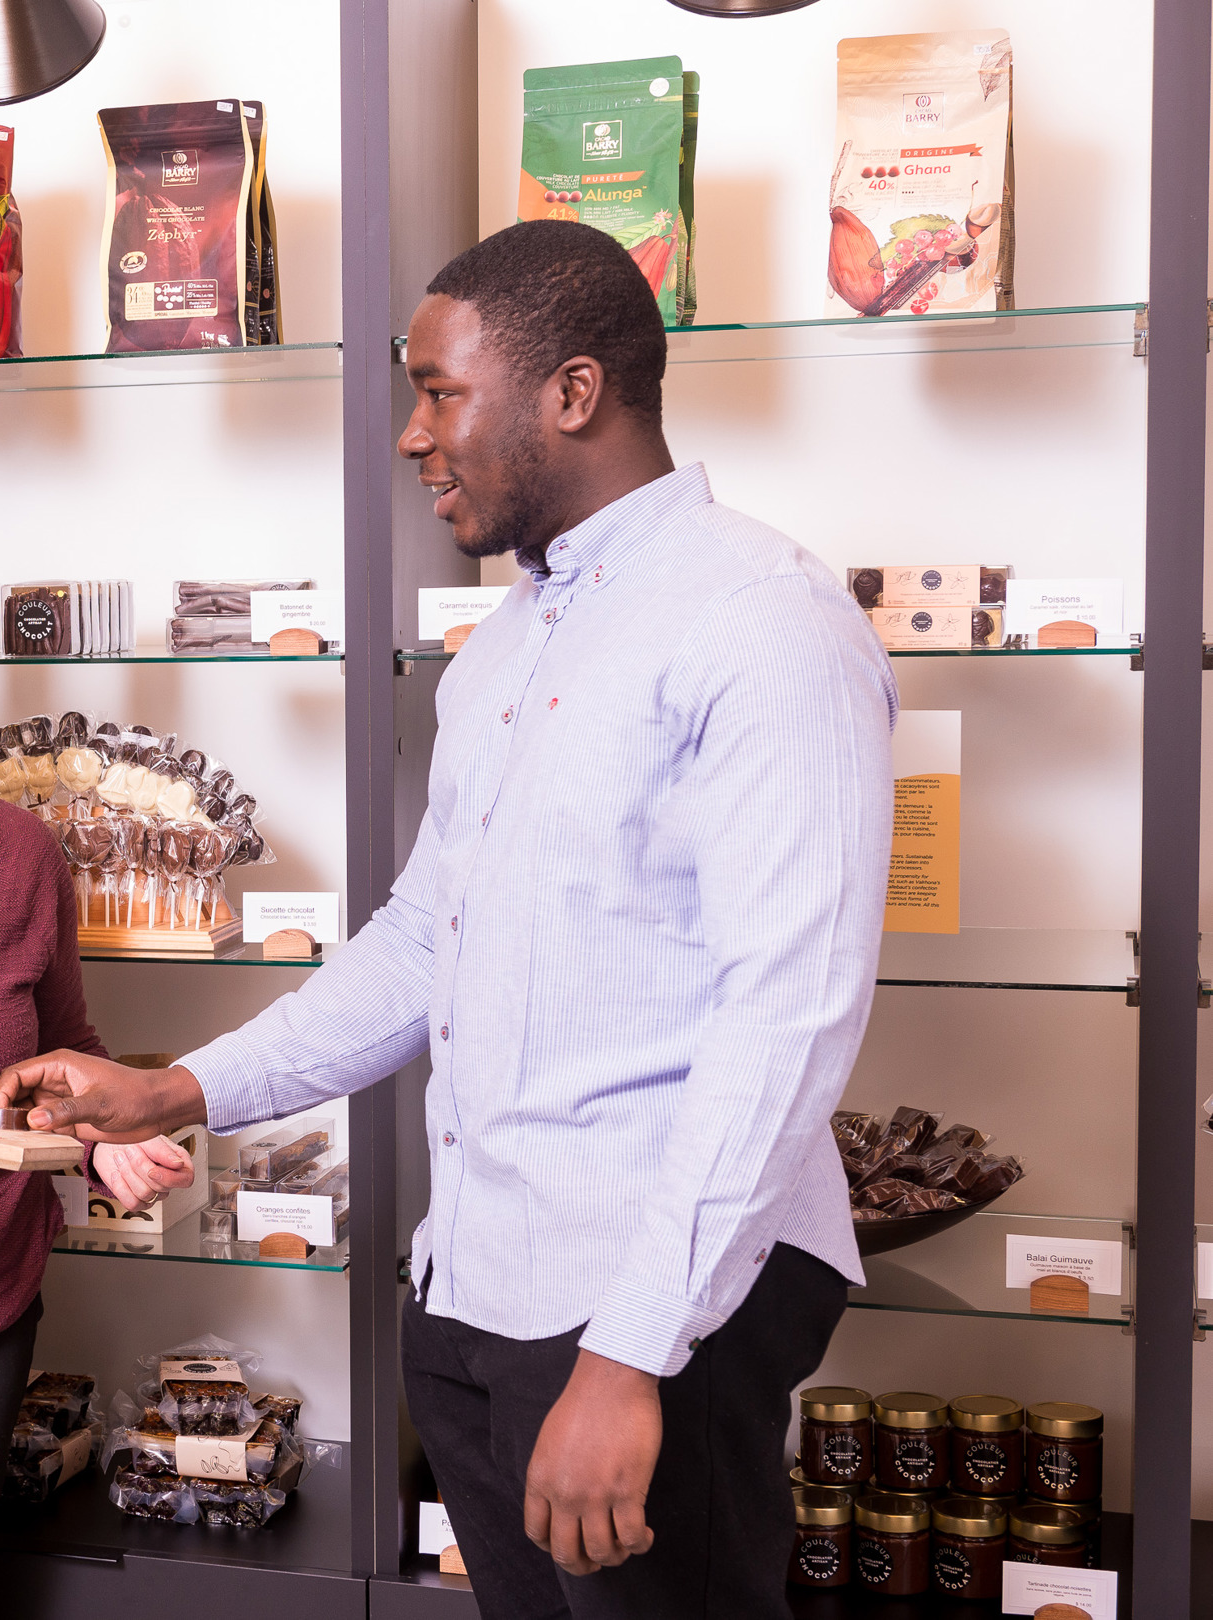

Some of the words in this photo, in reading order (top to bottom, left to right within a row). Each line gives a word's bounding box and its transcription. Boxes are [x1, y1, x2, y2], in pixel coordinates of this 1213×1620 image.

[905, 112, 941, 123] BARRY
[586, 140, 619, 151] BARRY
[905, 148, 954, 157] ORIGINE
[165, 168, 197, 178] BARRY
[904, 164, 951, 176] Ghana
[586, 174, 624, 183] PURETÉ
[868, 179, 895, 191] 40%
[546, 208, 577, 220] 41%
[469, 602, 493, 610] exquis
[1041, 595, 1081, 604] Poissons
[18, 601, 52, 617] COULEUR
[17, 621, 53, 640] CHOCOLAT
[260, 906, 286, 914] Sucette
[287, 906, 315, 914] chocolat
[256, 1205, 284, 1214] Oranges
[285, 1207, 311, 1215] confites
[1026, 1253, 1048, 1262] Balai
[1050, 1254, 1094, 1265] Guimauve
[825, 1435, 861, 1450] COULEUR
[896, 1441, 934, 1456] COULEUR
[967, 1443, 1005, 1459] COULEUR
[1039, 1449, 1078, 1467] COULEUR
[823, 1454, 862, 1475] CHOCOLAT
[894, 1460, 935, 1481] CHOCOLAT
[965, 1461, 1007, 1483] CHOCOLAT
[1037, 1465, 1079, 1490] CHOCOLAT
[800, 1539, 839, 1554] COULEUR
[799, 1557, 840, 1579] CHOCOLAT
[857, 1558, 892, 1583] CHOCOLAT
[934, 1565, 972, 1590] CHOCOLAT
